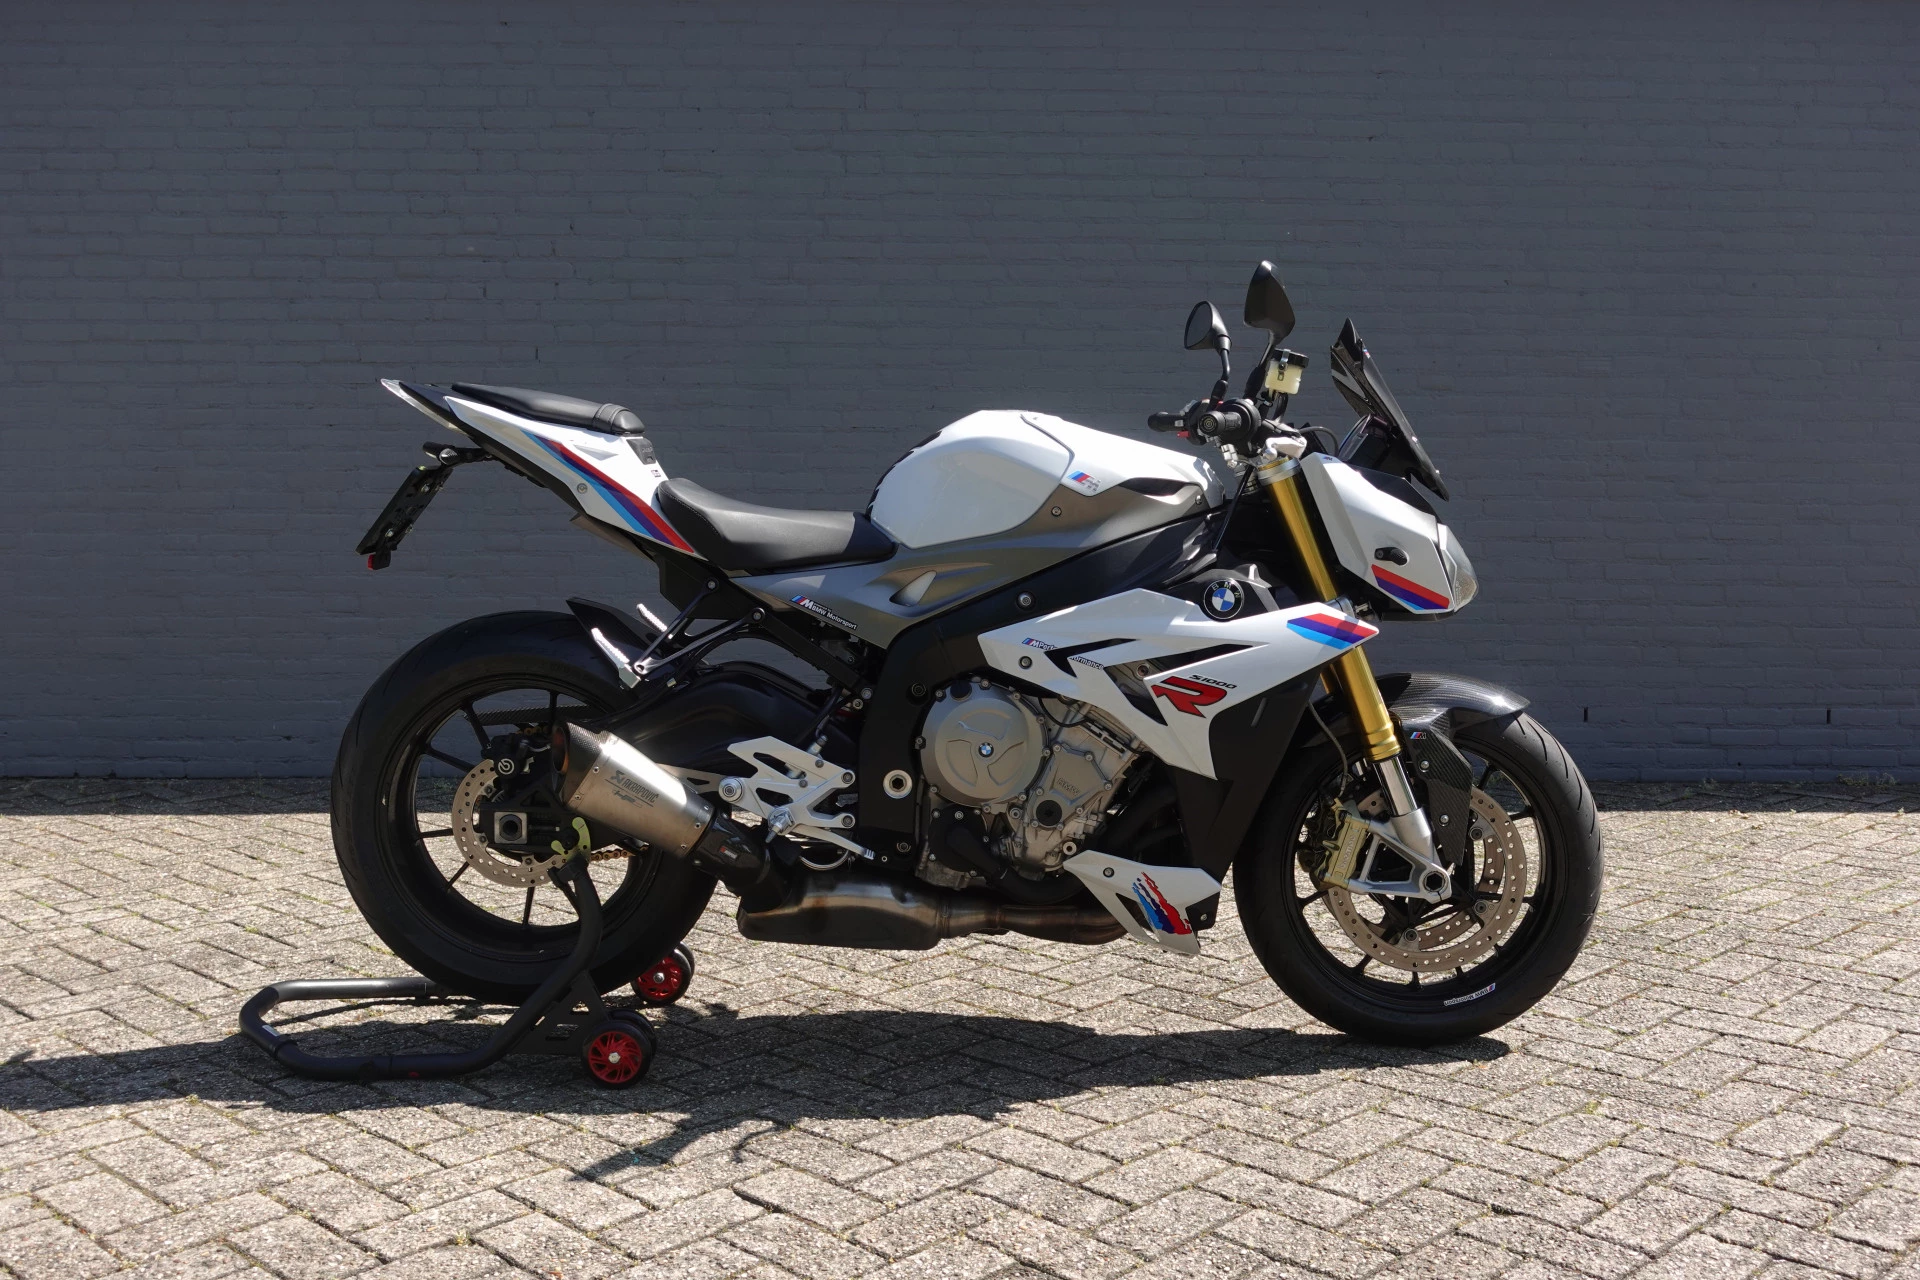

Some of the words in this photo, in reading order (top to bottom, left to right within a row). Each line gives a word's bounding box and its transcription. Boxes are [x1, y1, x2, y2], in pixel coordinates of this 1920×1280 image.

[1211, 581, 1241, 599] BMW
[812, 605, 827, 616] BMW
[826, 611, 858, 630] Motorsport
[1189, 674, 1238, 690] S1000
[1150, 675, 1228, 719] R
